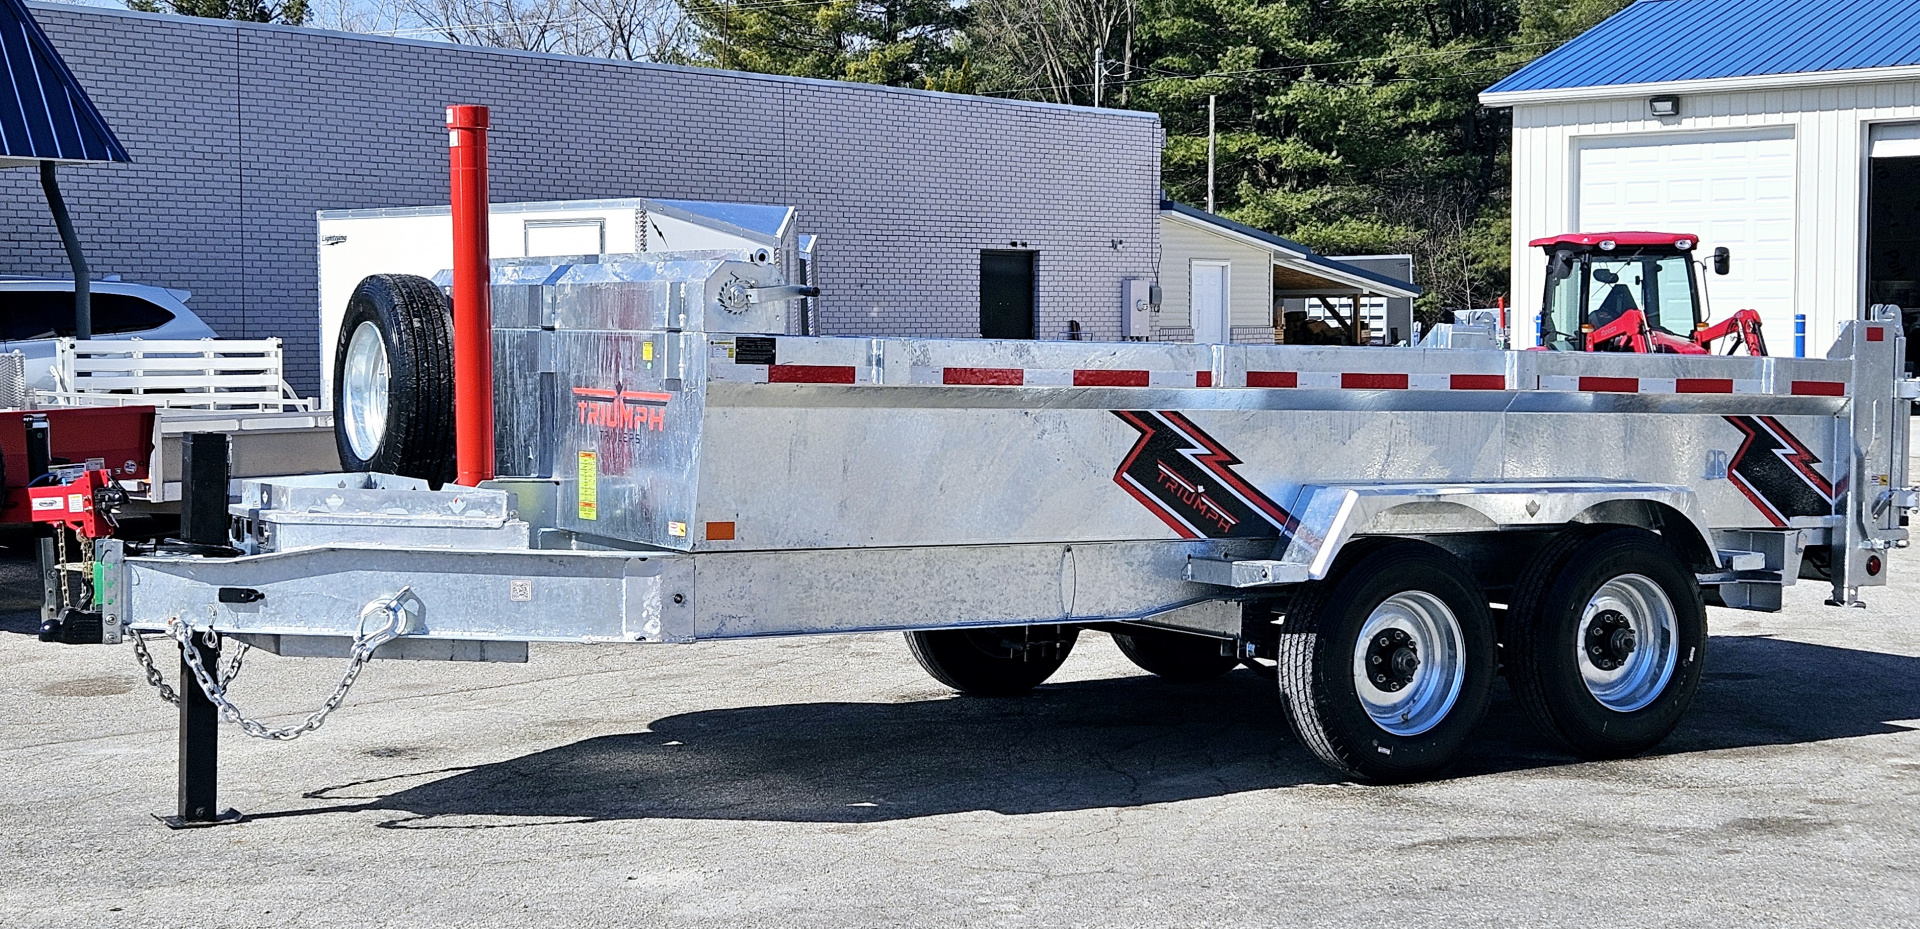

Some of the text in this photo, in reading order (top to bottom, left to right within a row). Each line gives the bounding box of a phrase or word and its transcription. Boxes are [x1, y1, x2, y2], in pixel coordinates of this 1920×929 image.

[577, 400, 665, 432] TRIUMPH
[599, 429, 641, 444] TRLERS
[1157, 470, 1232, 533] TRIUMPH
